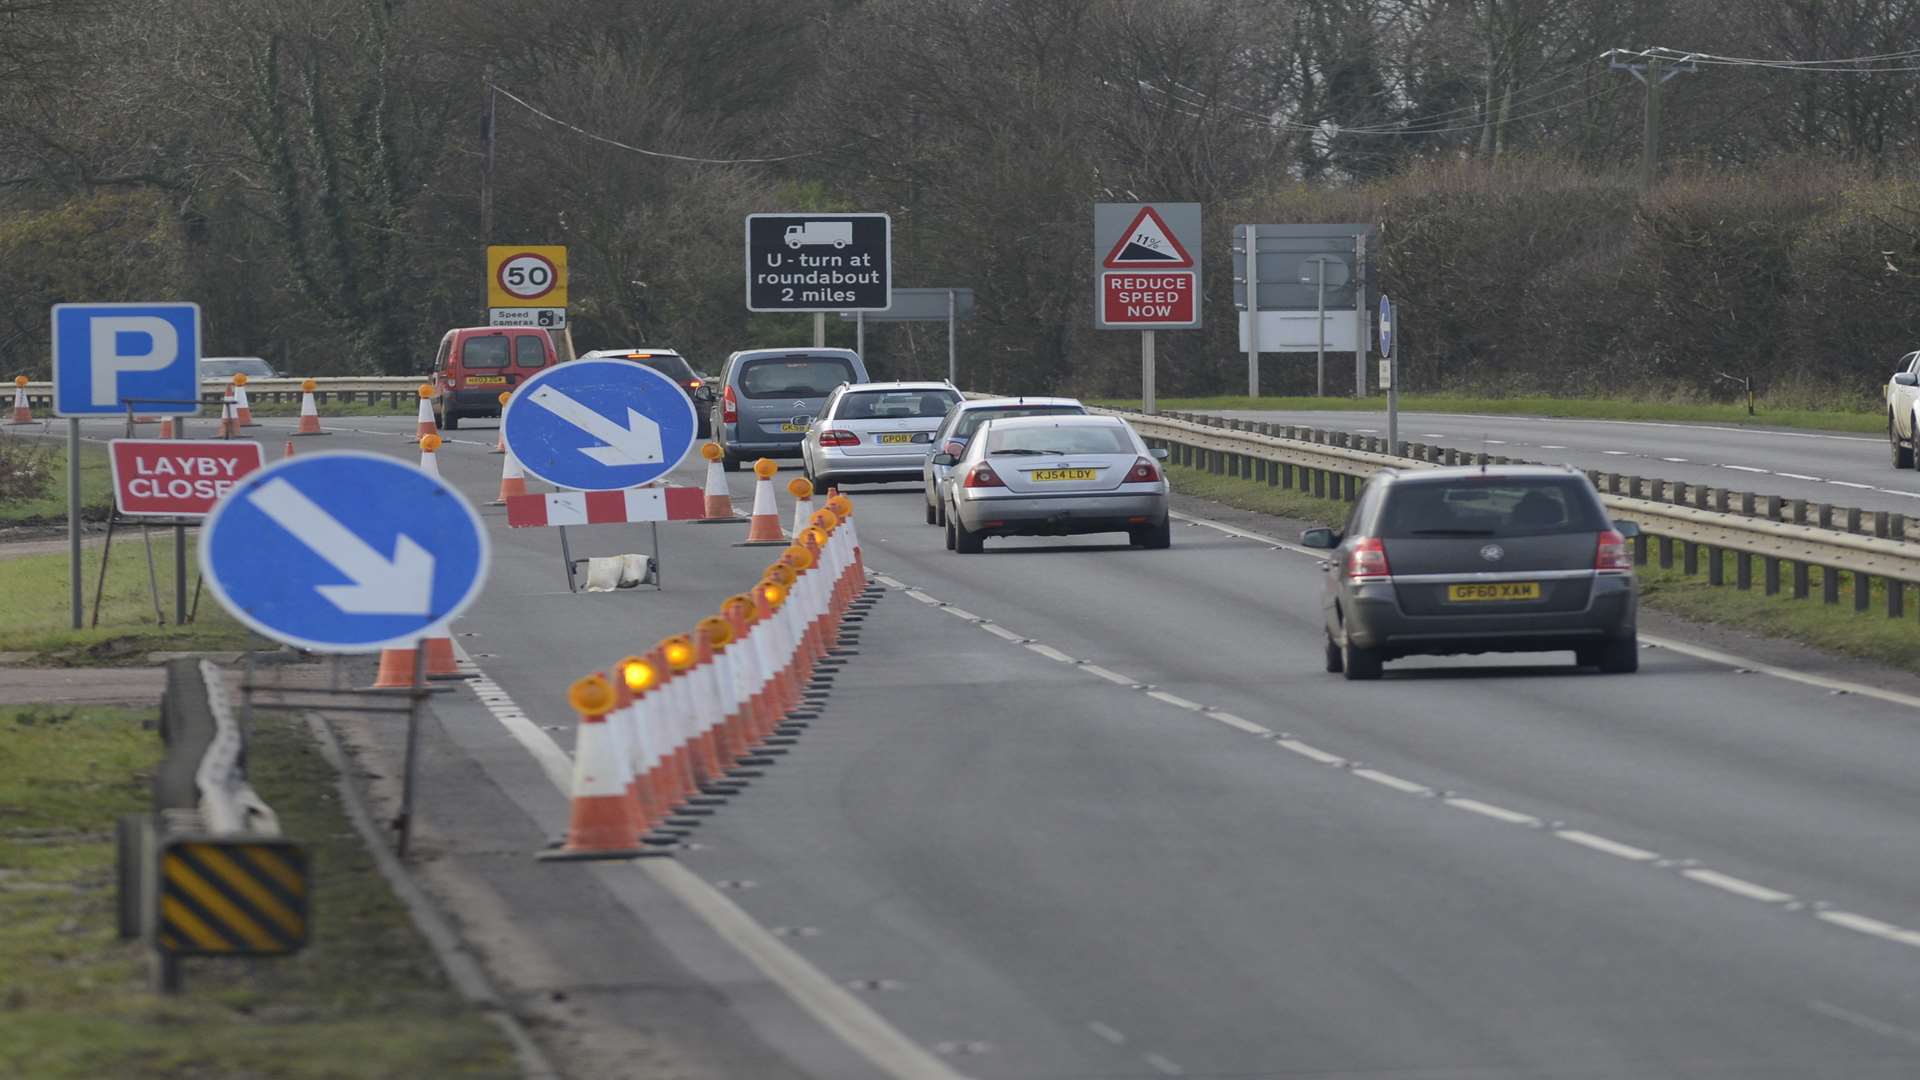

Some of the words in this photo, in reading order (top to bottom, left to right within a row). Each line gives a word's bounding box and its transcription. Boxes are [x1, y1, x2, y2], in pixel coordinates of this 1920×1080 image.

[1137, 234, 1161, 249] 11%
[850, 253, 871, 267] at
[508, 267, 548, 286] 50
[758, 270, 880, 284] roundabout
[1111, 278, 1186, 290] REDUCE
[781, 288, 794, 301] 2
[802, 288, 856, 301] miles
[1119, 292, 1179, 303] SPEED
[498, 311, 529, 319] Speed
[1127, 305, 1172, 317] NOW
[90, 316, 179, 406] P
[135, 456, 238, 477] LAYBY
[1036, 470, 1066, 480] KJ54
[128, 478, 240, 499] CLOSE
[1456, 585, 1498, 598] GF60
